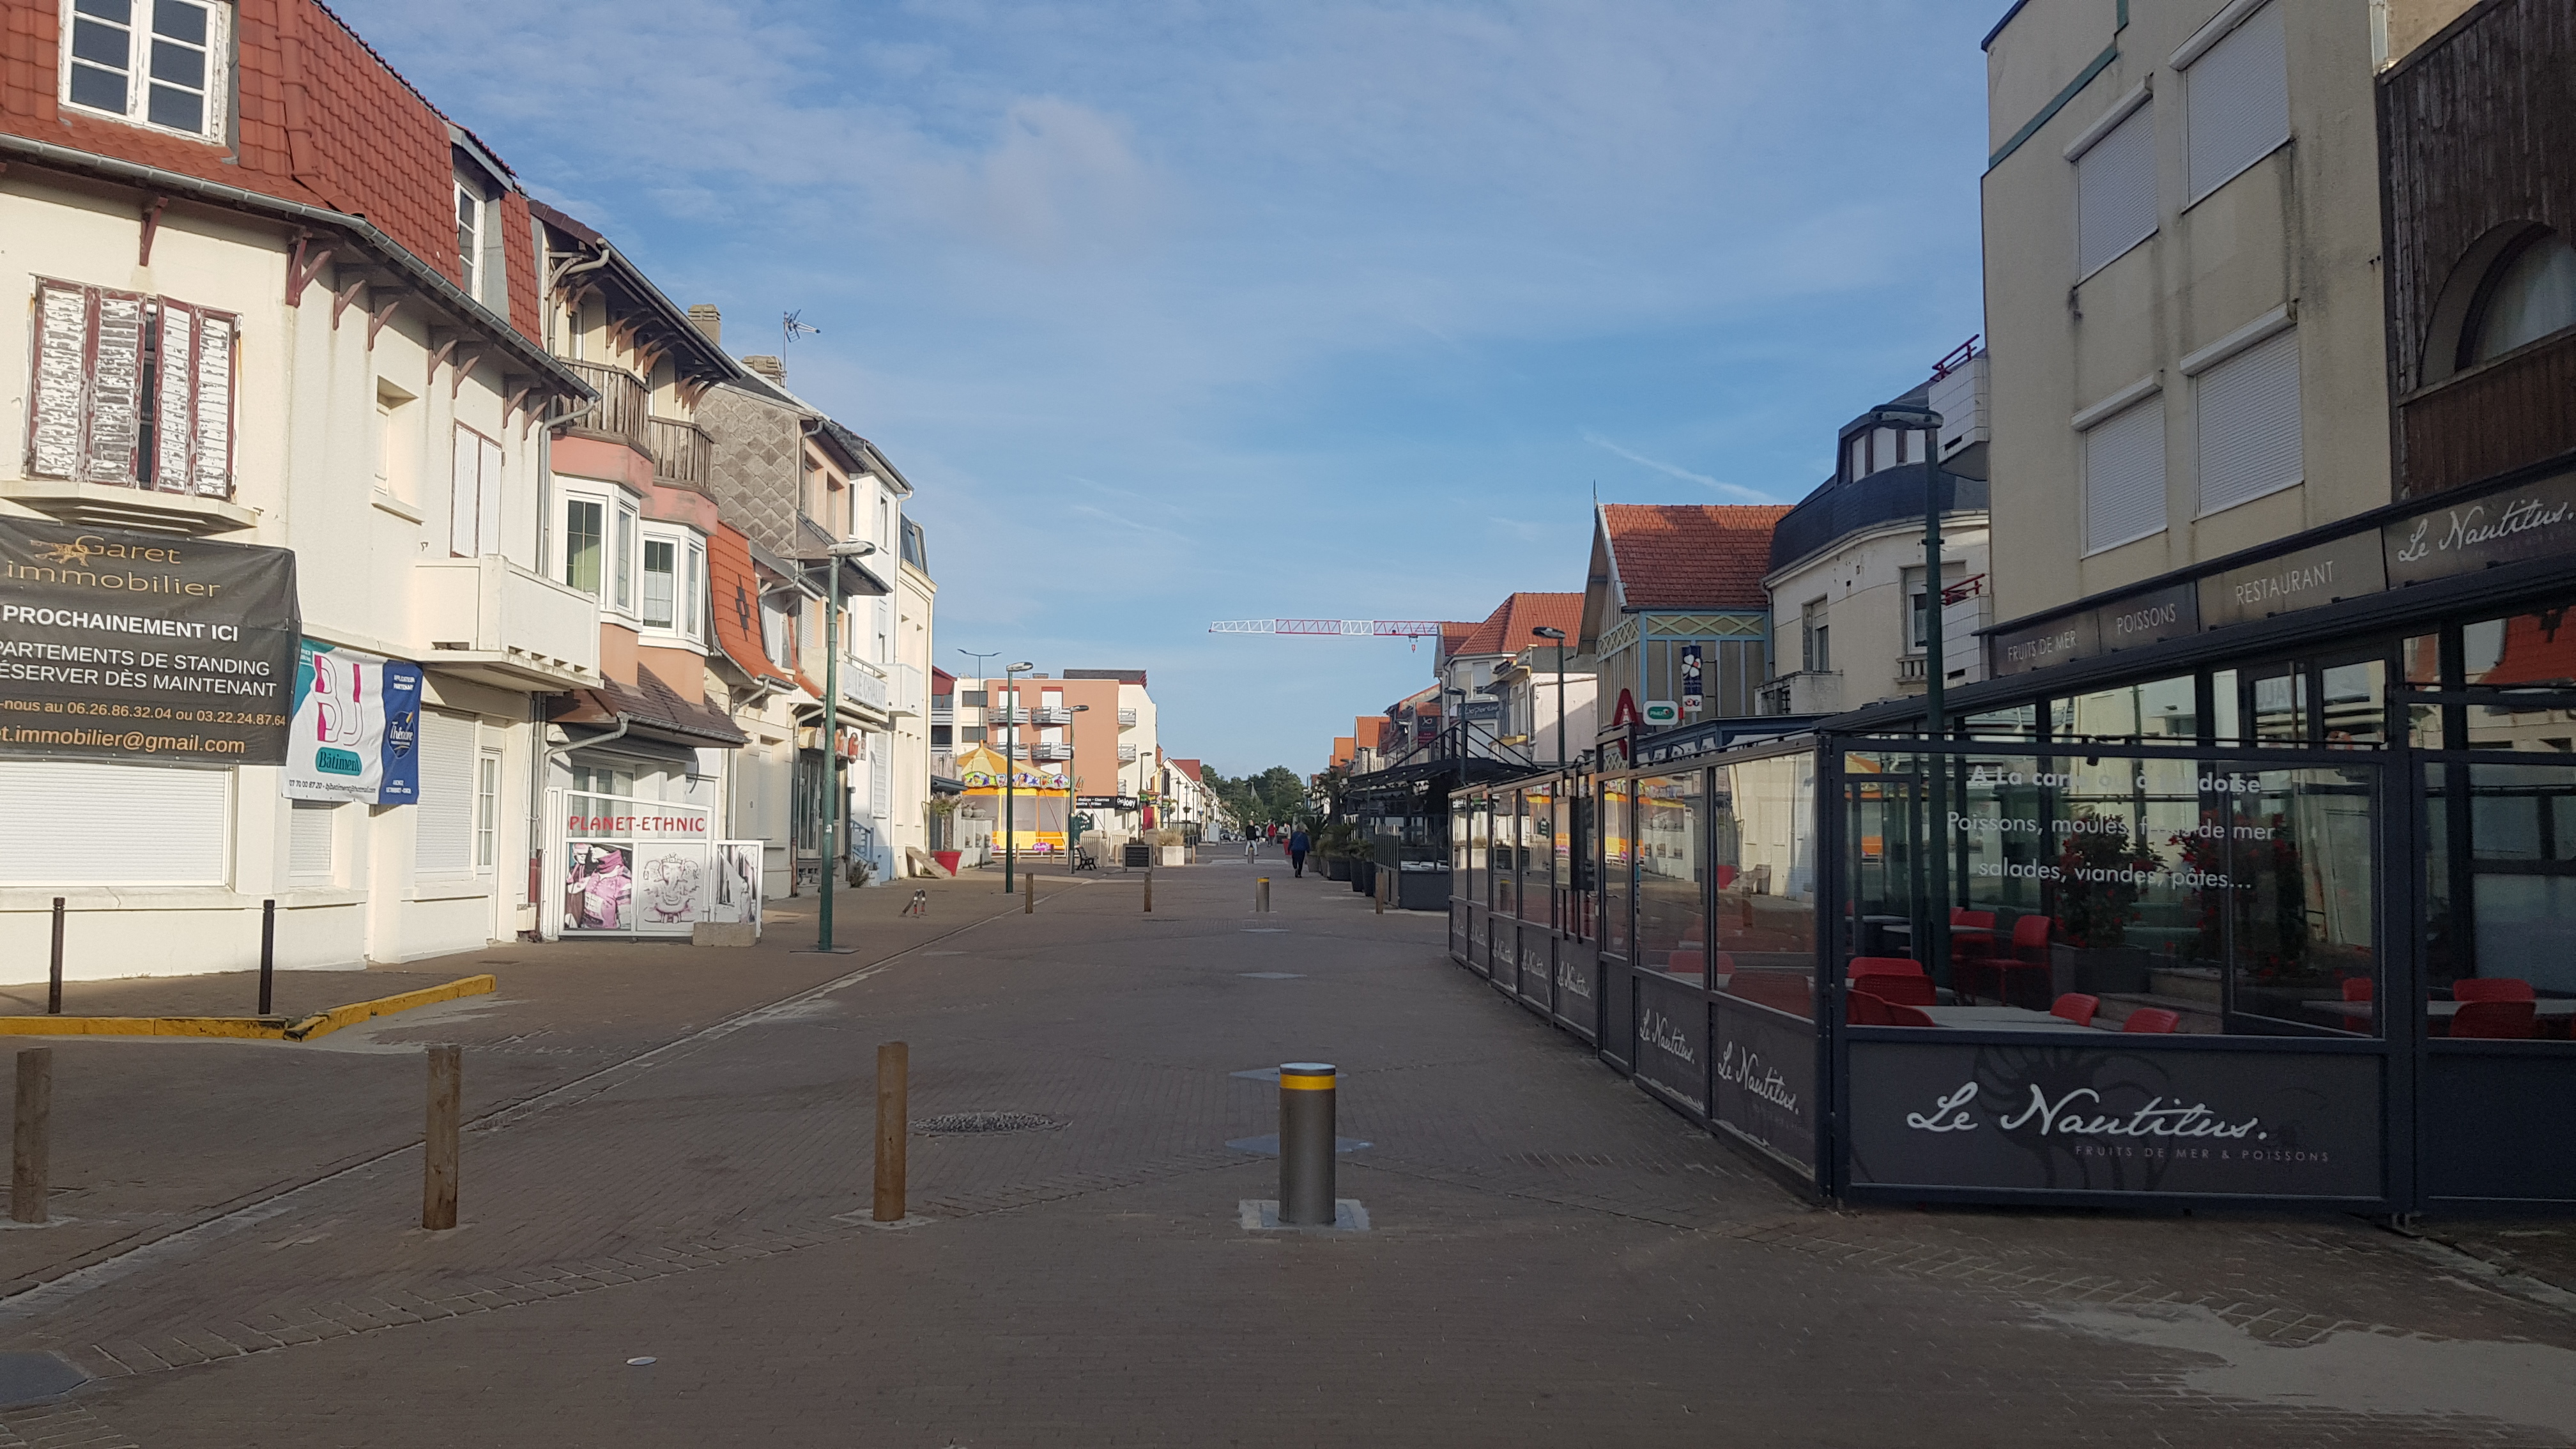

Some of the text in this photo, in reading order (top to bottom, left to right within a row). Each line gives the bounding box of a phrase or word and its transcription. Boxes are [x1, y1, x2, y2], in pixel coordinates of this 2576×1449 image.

[75, 535, 181, 564] Garet
[2398, 518, 2429, 562] Le
[7, 560, 221, 597] immobilier
[2236, 560, 2334, 605] RESTAURANT
[2, 604, 238, 641] PROCHAINEMENT ICI
[2116, 603, 2175, 635] POISSONS
[0, 641, 270, 677] ARTEMENTS DE STANDING
[2008, 630, 2076, 661] FRUITS DE MER
[105, 669, 148, 688] DÈS
[154, 674, 277, 697] MAINTENANT
[44, 703, 63, 713] au
[67, 702, 172, 719] 06.26.86.32.04
[176, 710, 192, 721] ou
[196, 710, 286, 726] 03.22.24.87.64
[0, 724, 246, 754] t.immobilier@gmail.com
[319, 751, 360, 772] Bâtiment
[1970, 765, 1988, 783] A
[2032, 770, 2082, 787] car
[568, 815, 705, 832] PLANET-ETHNIC
[1946, 811, 2043, 836] Poissons,
[2199, 818, 2225, 839] de
[2233, 825, 2276, 840] mer
[1979, 856, 2251, 891] salades, viandes, pâtes...
[1639, 1008, 1650, 1041] Le
[1717, 1040, 1733, 1080] Le
[1906, 1081, 1979, 1132] Le
[2075, 1146, 2133, 1157] FRUITS
[2145, 1147, 2165, 1158] DE
[2176, 1148, 2210, 1160] MER
[2241, 1149, 2329, 1162] POISSONS
